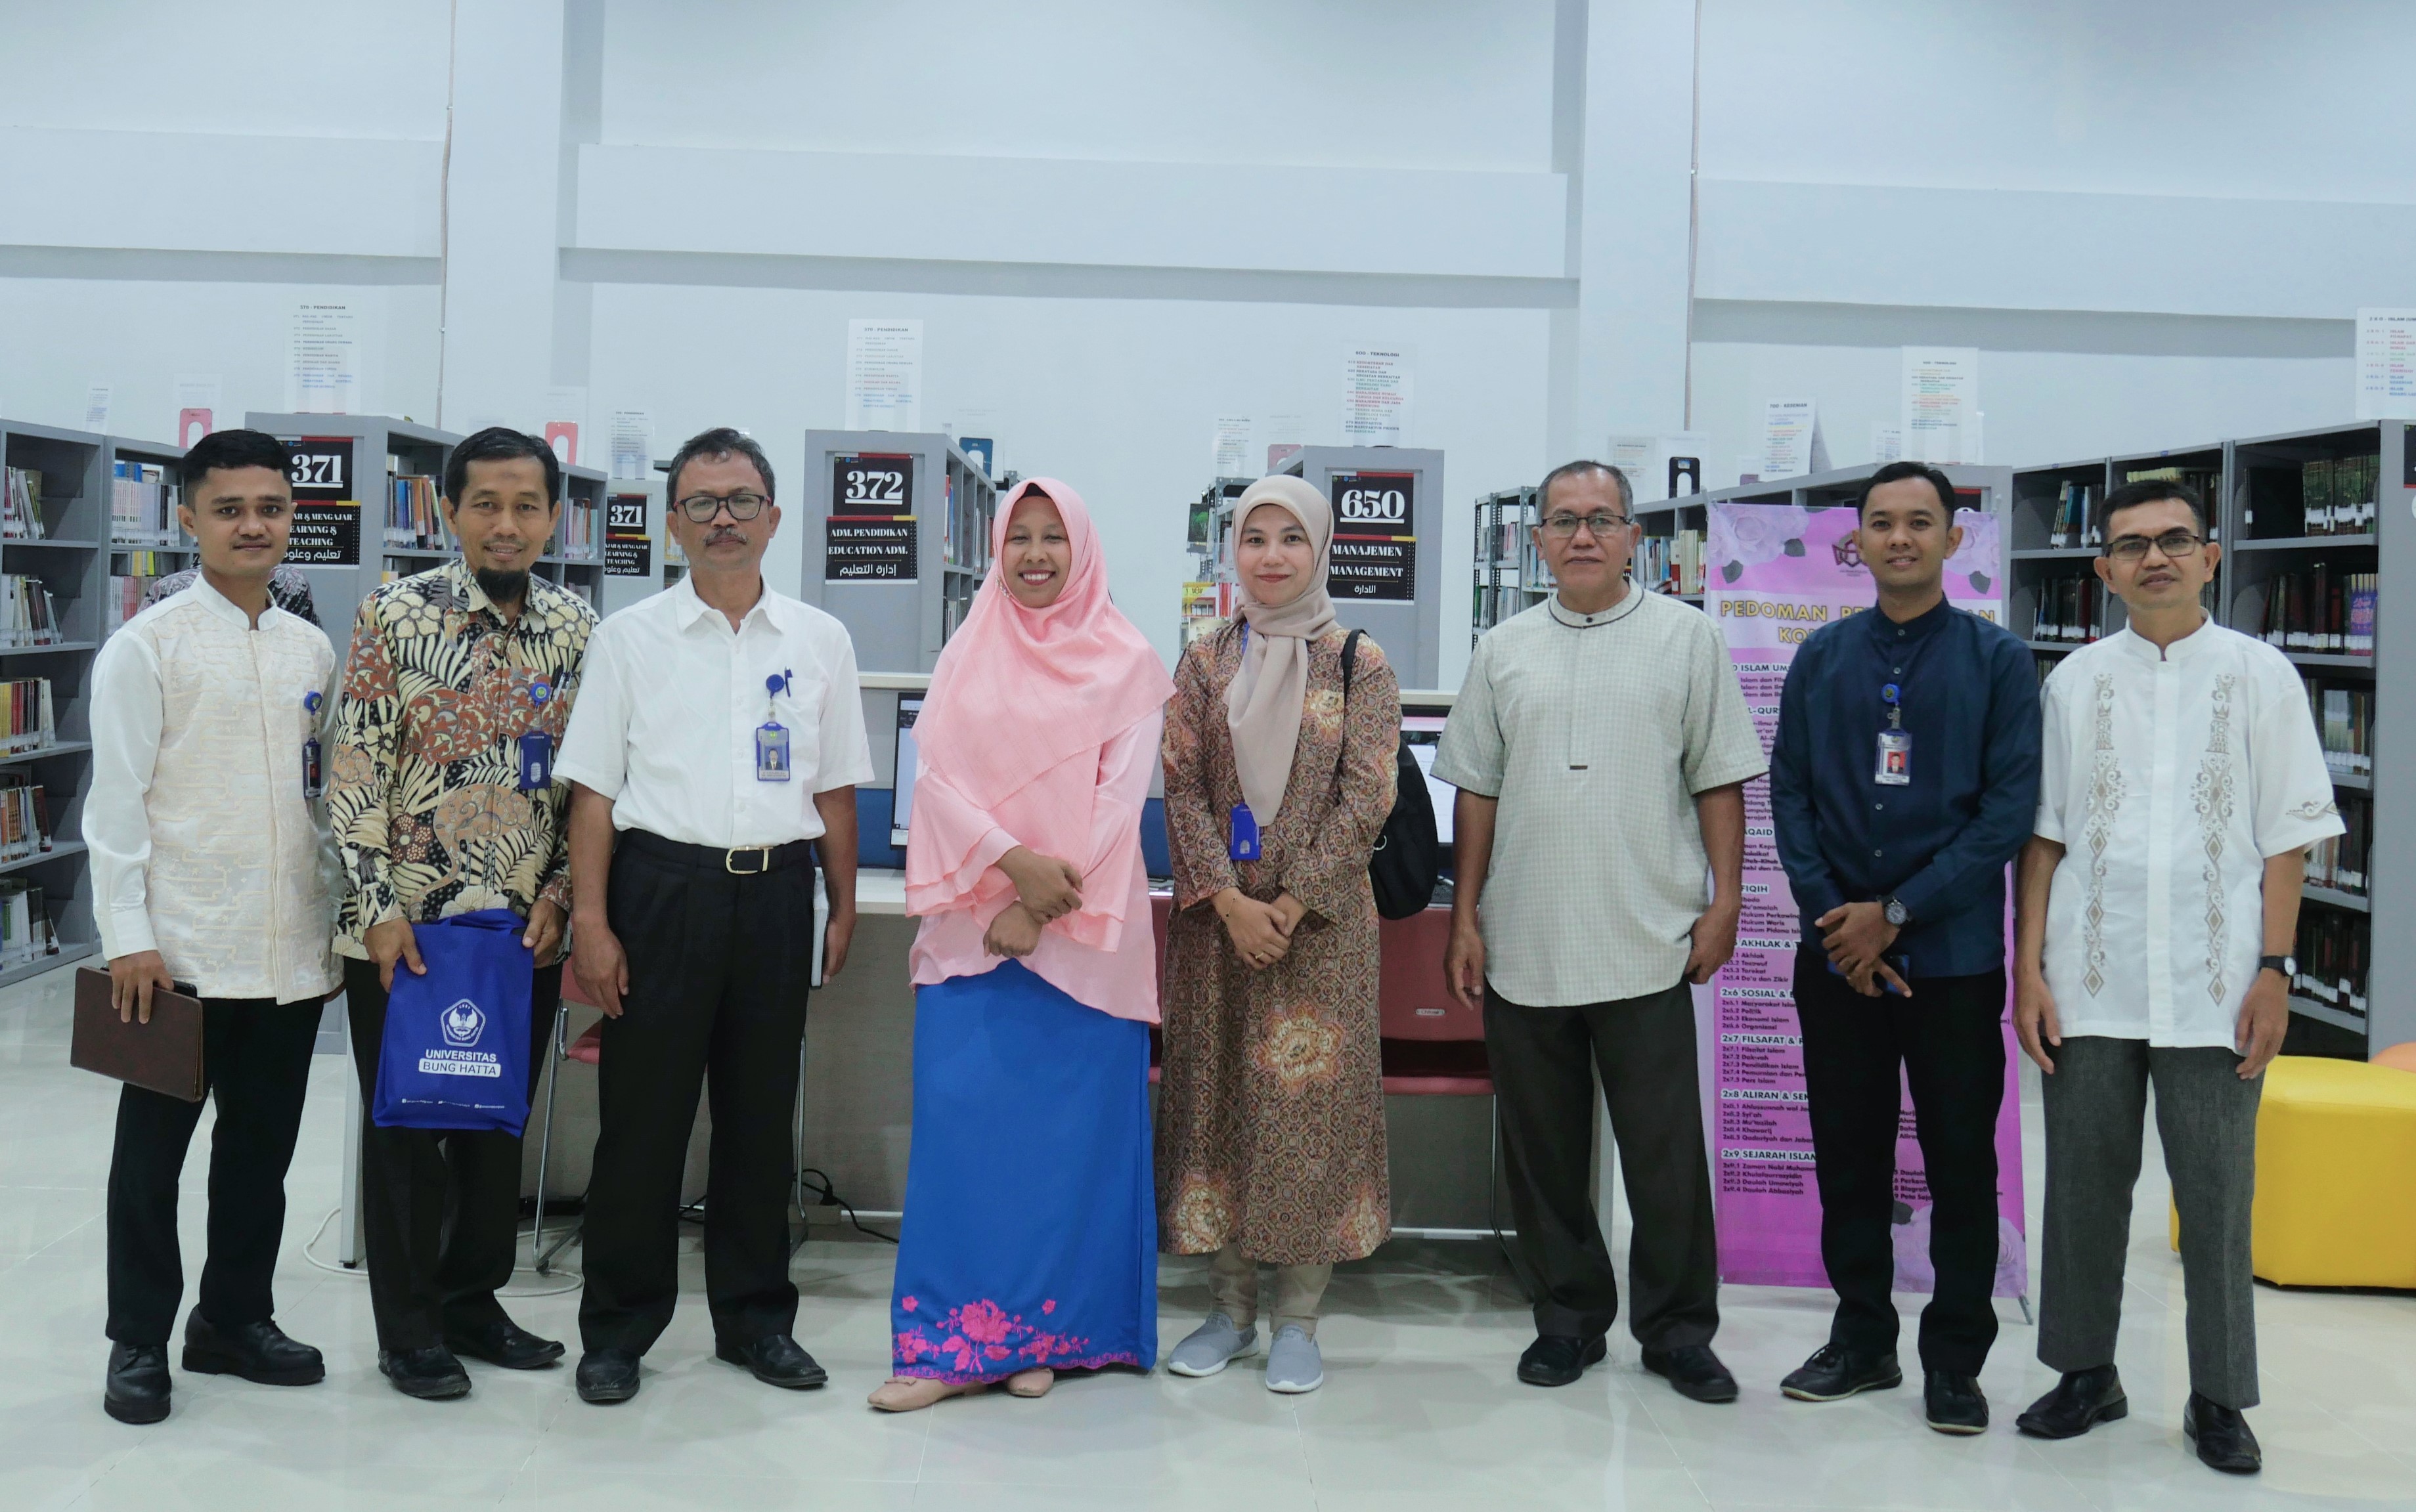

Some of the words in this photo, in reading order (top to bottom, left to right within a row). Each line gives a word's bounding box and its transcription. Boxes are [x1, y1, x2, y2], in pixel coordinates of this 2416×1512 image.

[291, 454, 343, 483] 371
[846, 471, 903, 500] 372
[1341, 489, 1405, 519] 650
[611, 505, 643, 523] 371
[330, 526, 337, 536] &
[314, 549, 341, 561] تعليم
[828, 546, 883, 555] EDUCATION
[885, 546, 908, 555] ADM.
[1332, 544, 1402, 557] MANAJEMEN
[840, 564, 873, 576] التعليم
[876, 564, 896, 576] إدارة
[1330, 566, 1403, 577] MANAGEMENT
[1721, 600, 1828, 622] PEDOMAN
[426, 1049, 496, 1062] UNIVERSITAS
[423, 1062, 456, 1073] BUNG
[460, 1064, 496, 1075] HATTA
[1743, 1151, 1786, 1159] SEJARAH
